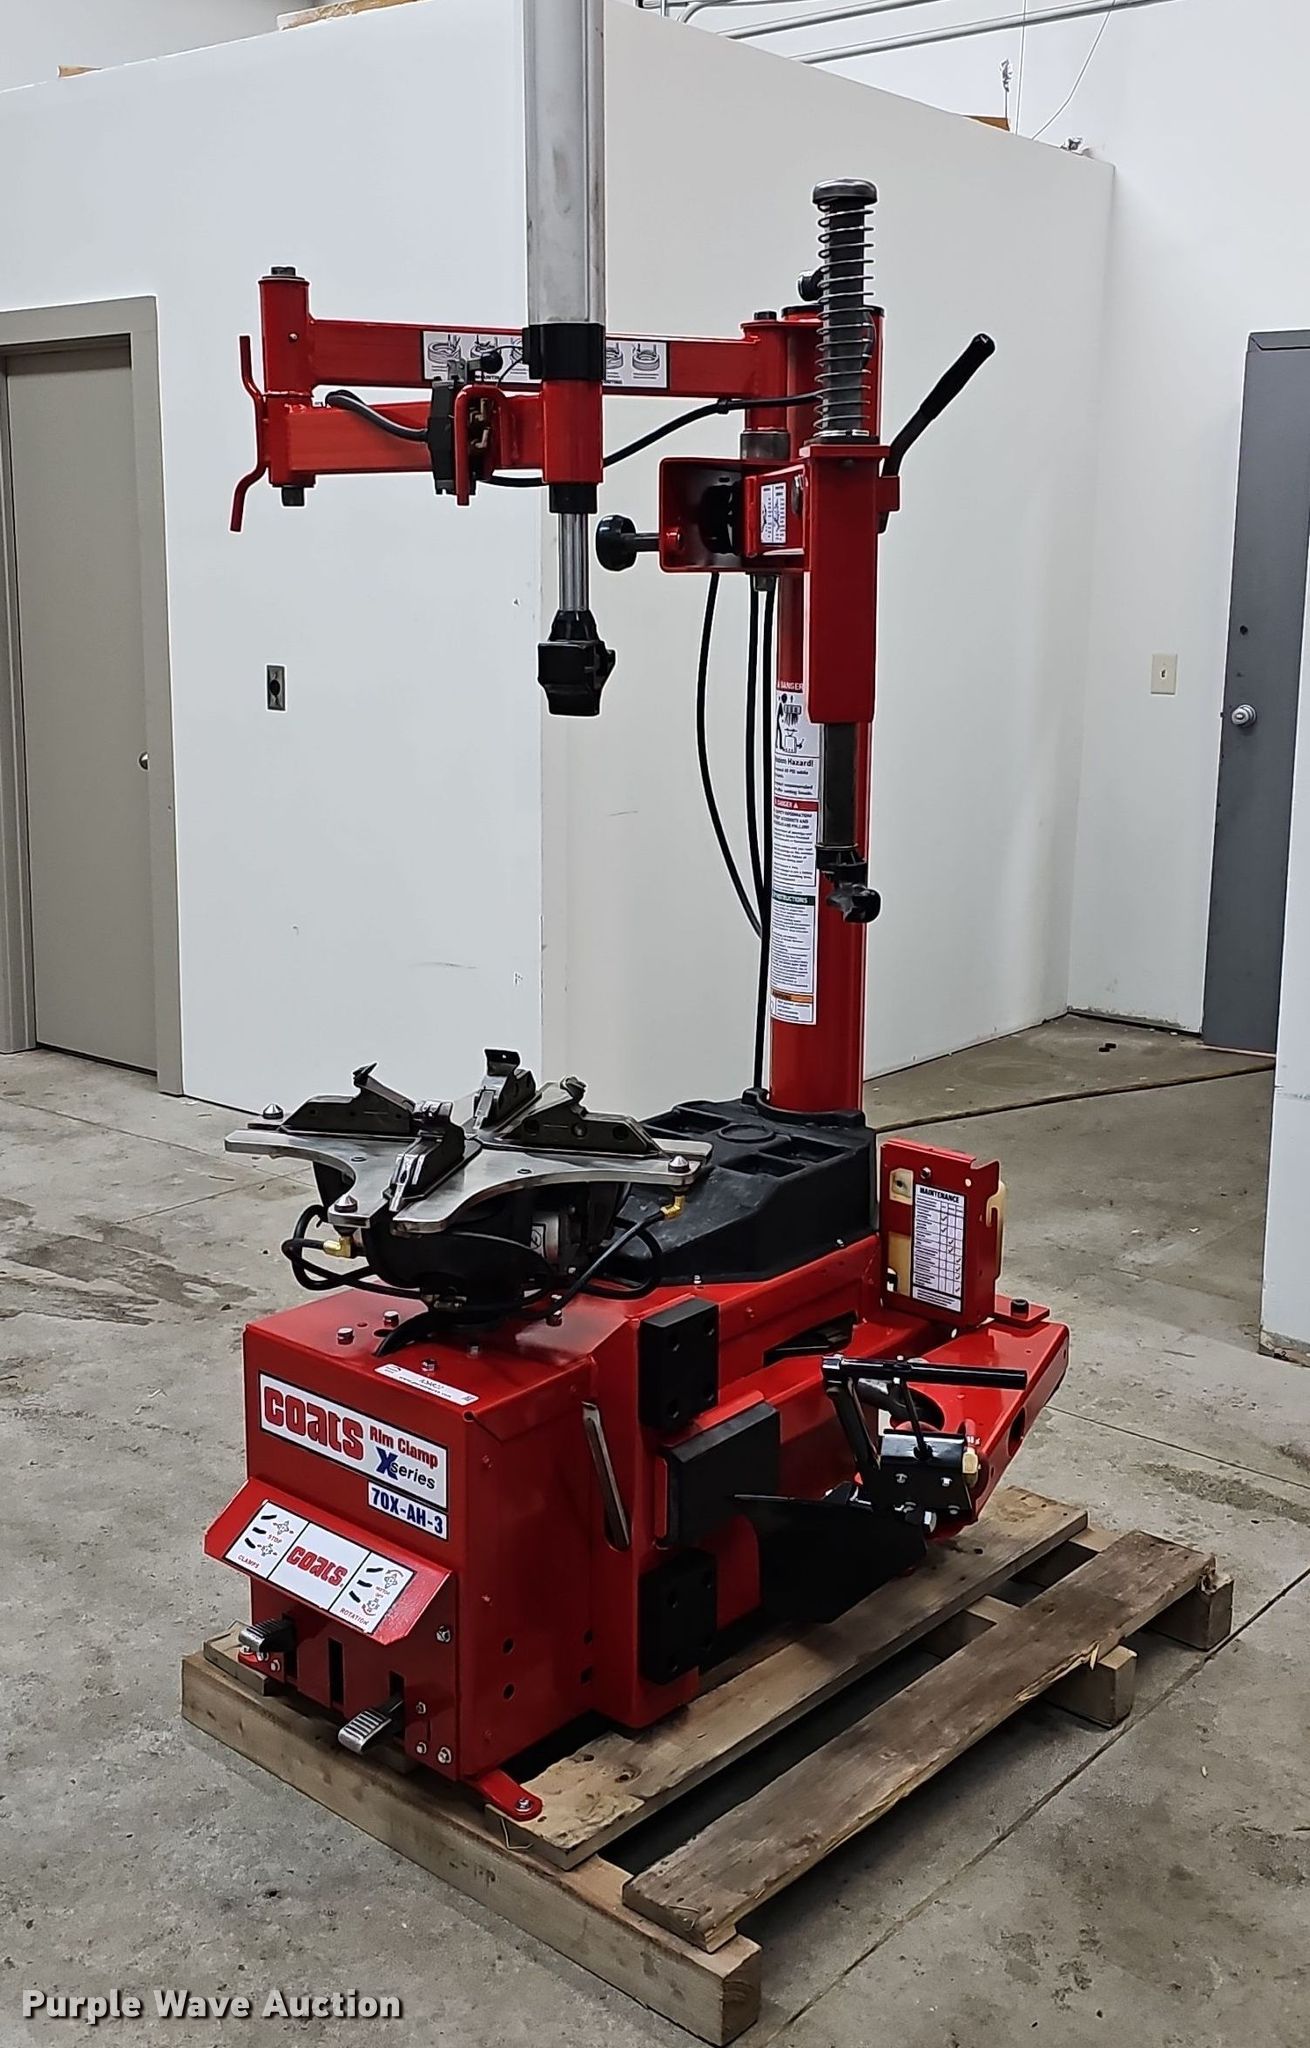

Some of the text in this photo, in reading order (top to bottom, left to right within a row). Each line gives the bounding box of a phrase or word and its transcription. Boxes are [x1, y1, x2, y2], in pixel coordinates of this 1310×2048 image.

[920, 1187, 960, 1203] MAINTENANCE
[369, 1425, 439, 1469] Rim Clamp
[371, 1487, 444, 1535] 70X-AH-3
[267, 1534, 283, 1544] STOP
[237, 1554, 260, 1569] CLAMPS
[339, 1608, 370, 1625] ROTATION
